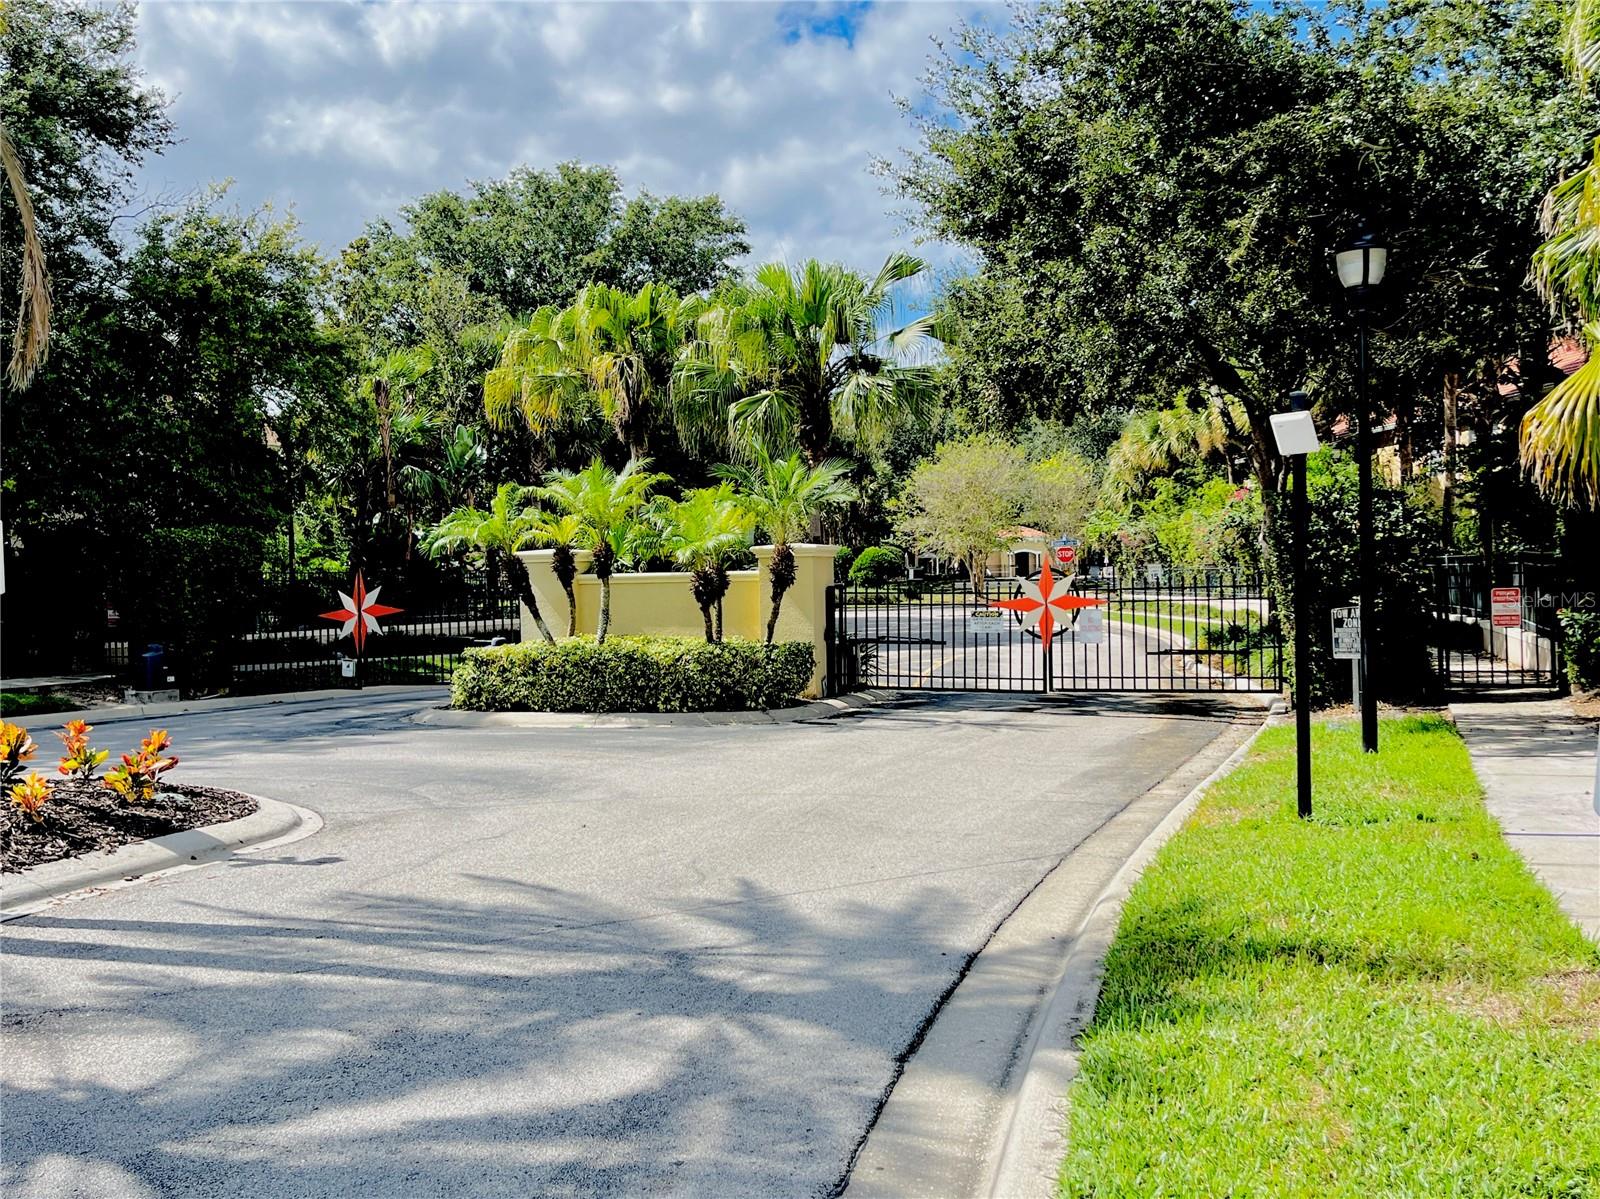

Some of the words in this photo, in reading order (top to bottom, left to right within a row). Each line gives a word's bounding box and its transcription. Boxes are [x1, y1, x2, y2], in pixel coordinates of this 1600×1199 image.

[1057, 550, 1073, 558] STOP
[1333, 609, 1348, 619] TOW
[1350, 608, 1360, 618] AW
